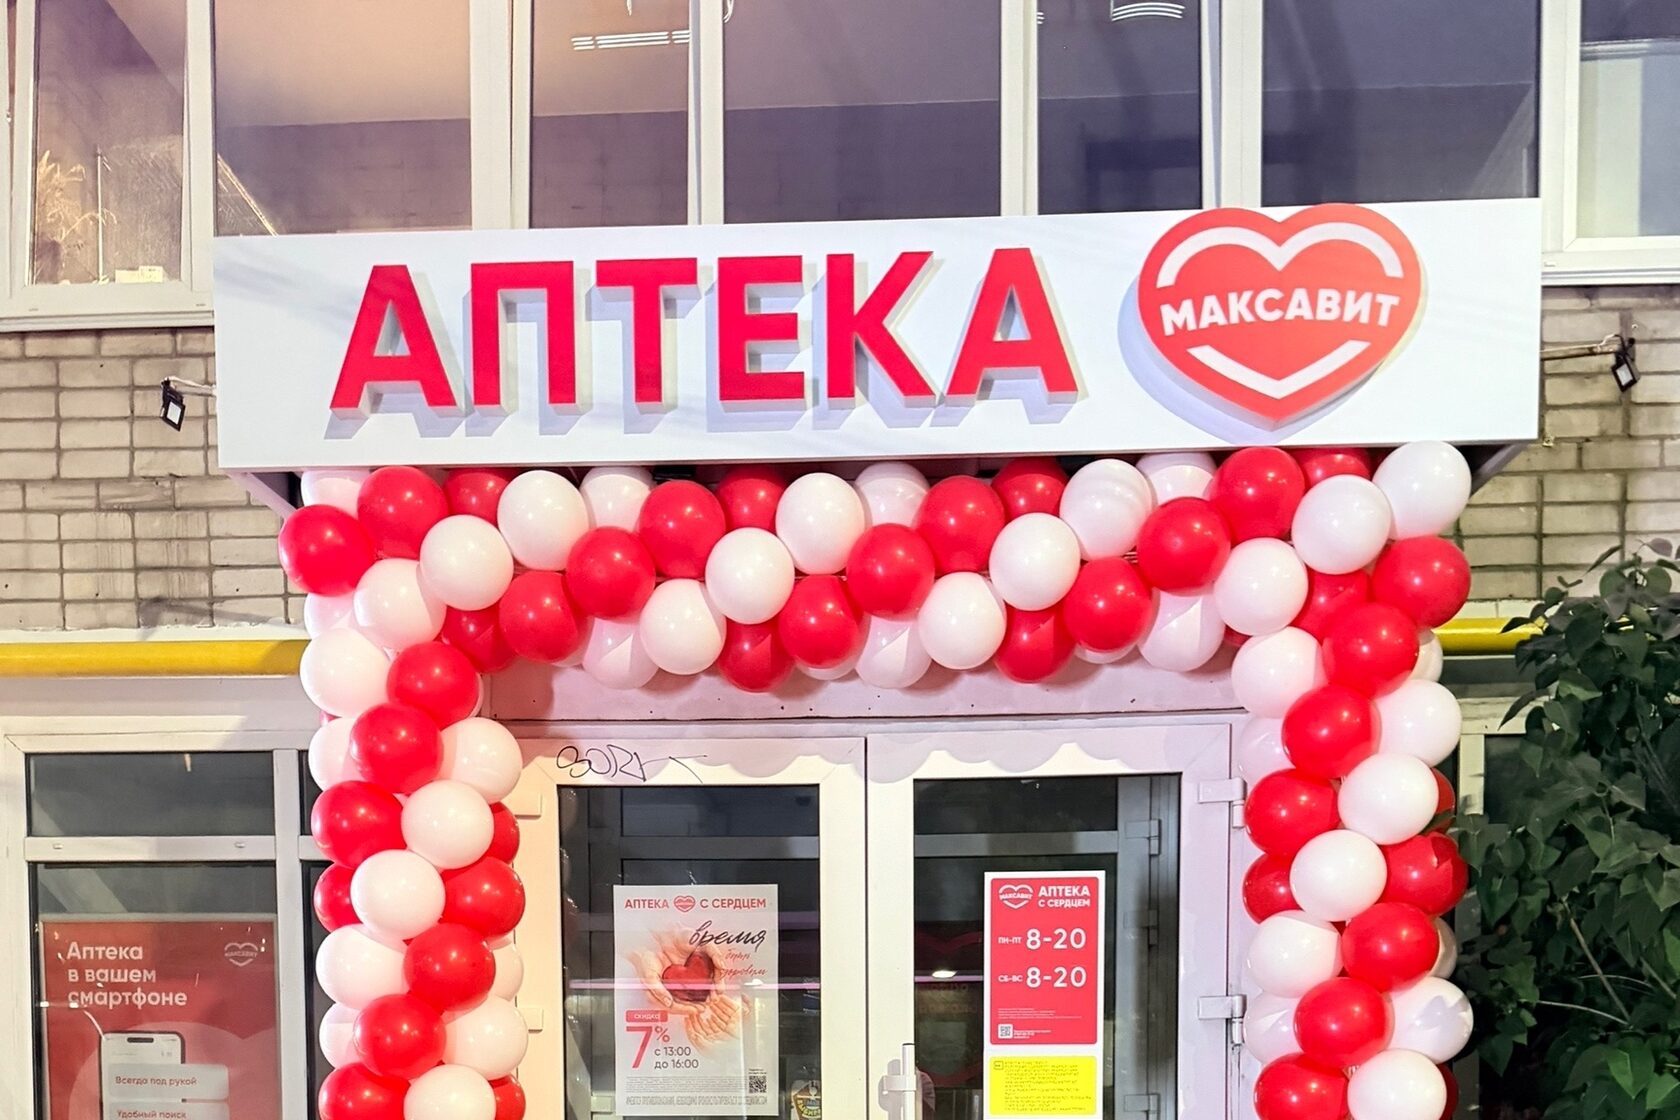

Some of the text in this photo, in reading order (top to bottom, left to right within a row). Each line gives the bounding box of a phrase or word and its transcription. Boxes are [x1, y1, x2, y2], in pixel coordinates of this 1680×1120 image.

[1160, 288, 1400, 336] МАКСАВИТ
[329, 248, 1082, 410] АПТЕКА
[1038, 885, 1091, 897] АПТЕКА
[624, 898, 670, 909] АПТЕКА
[700, 898, 709, 909] С
[711, 898, 767, 910] СЕРДЦЕМ
[1038, 899, 1091, 908] С СЕРДЦЕМ
[688, 919, 767, 953] время
[1026, 928, 1087, 950] 8-20
[66, 941, 144, 960] Аптека
[67, 969, 157, 983] в вашем
[1026, 966, 1087, 988] 8-20
[67, 987, 188, 1010] смартфоне
[654, 1046, 692, 1056] с 13:00
[654, 1059, 699, 1069] до 16:00
[115, 1076, 197, 1086] Всегда под рукой
[117, 1110, 187, 1119] Удобный поиск
